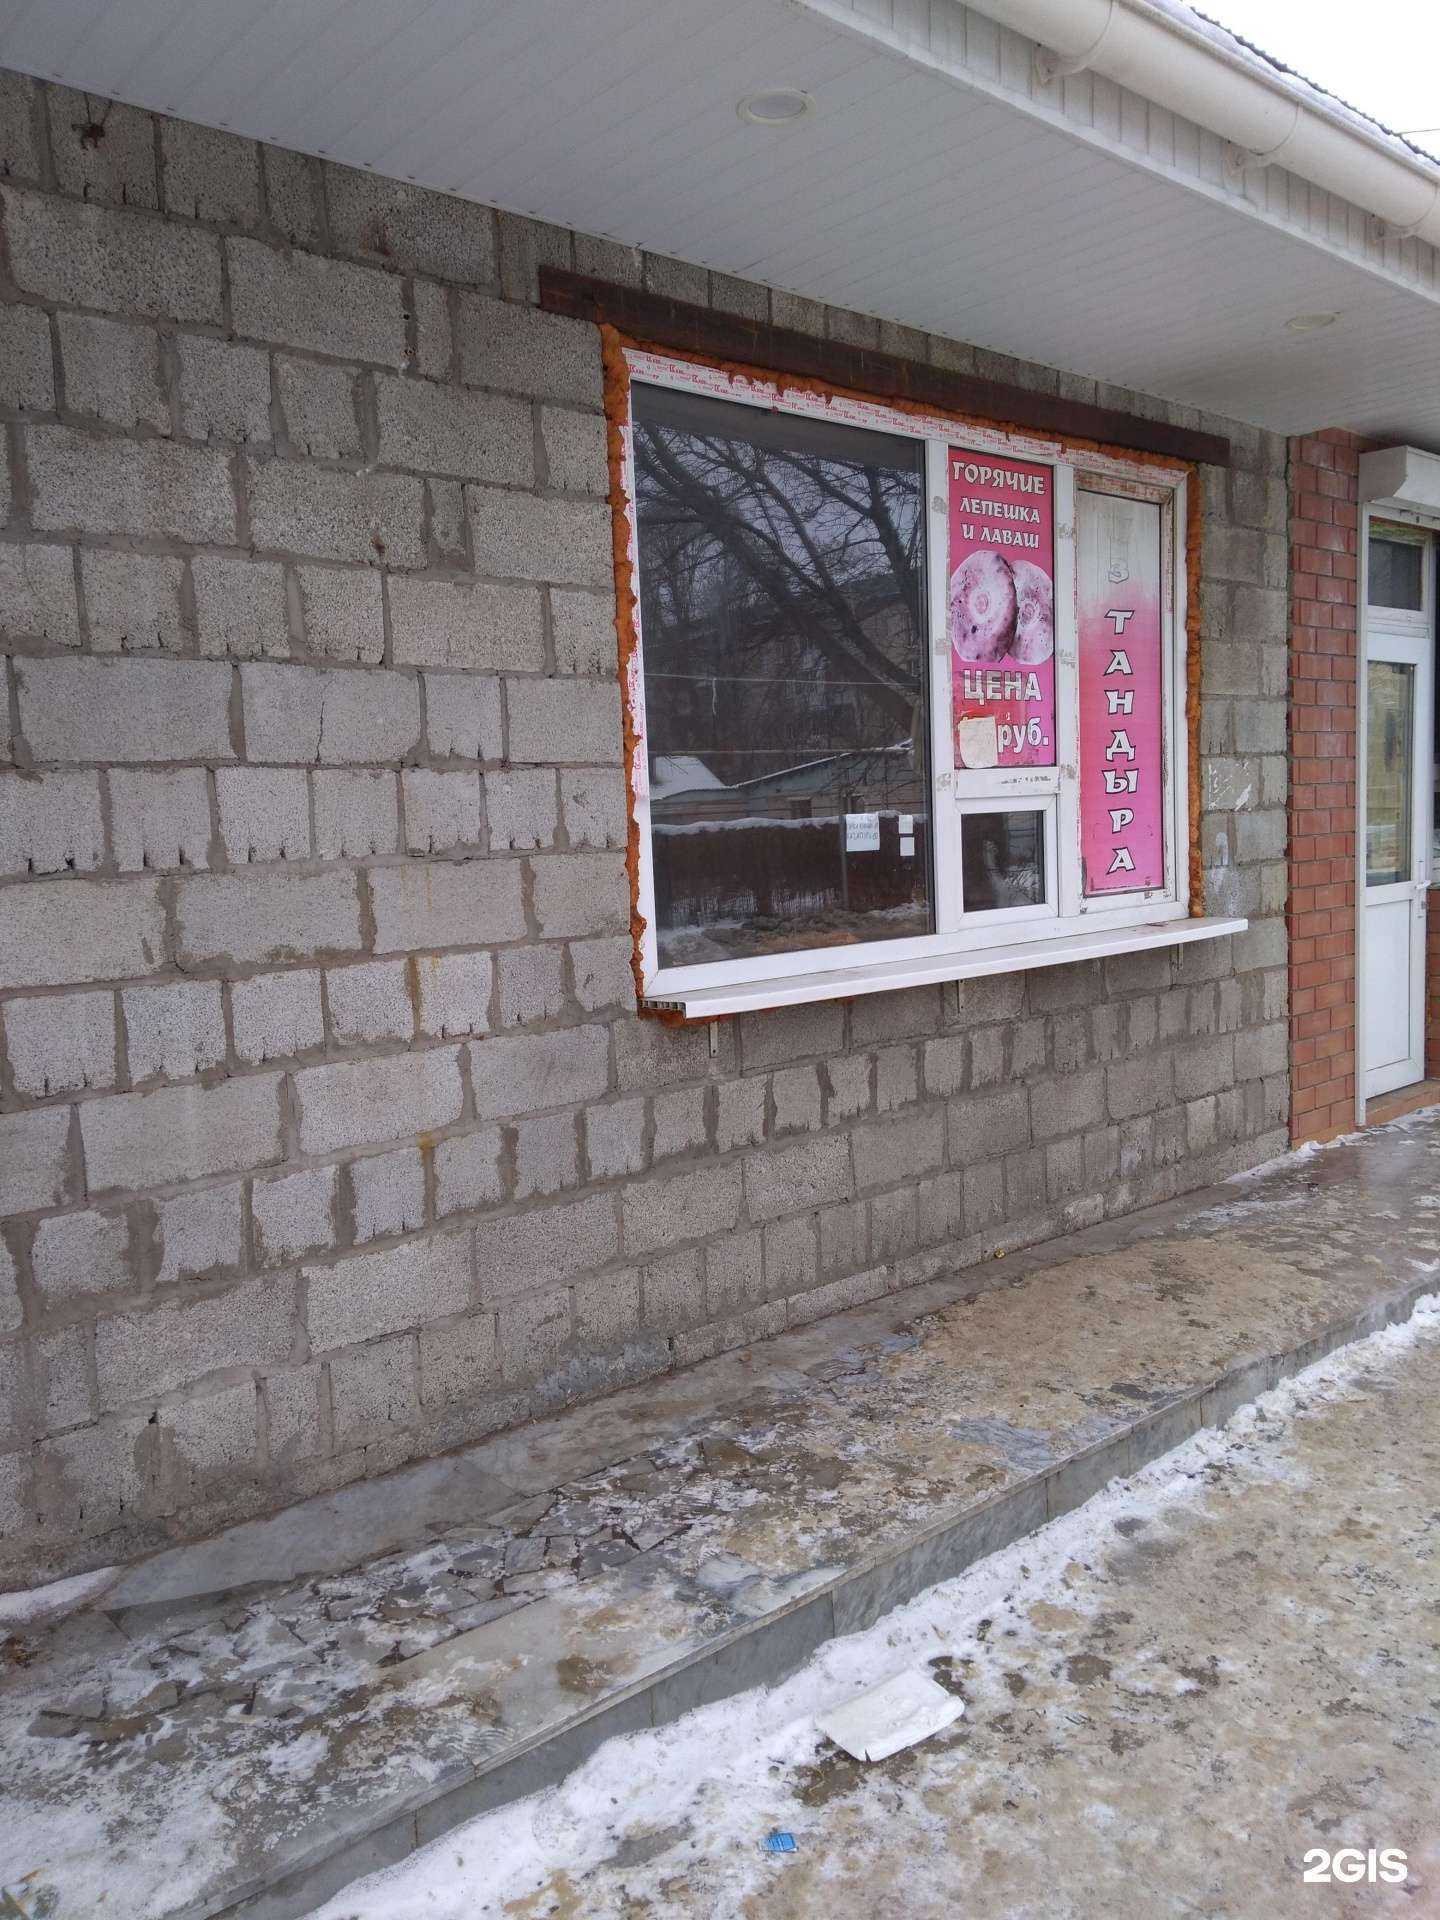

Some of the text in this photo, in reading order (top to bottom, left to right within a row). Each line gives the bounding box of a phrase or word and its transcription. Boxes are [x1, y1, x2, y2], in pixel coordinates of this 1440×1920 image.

[951, 461, 1046, 496] ГОРЯЧИЕ
[959, 496, 1041, 524] ЛЕПЕШКА
[961, 523, 975, 541] И
[980, 526, 1040, 550] ЛАВАШ
[962, 668, 1043, 706] ЦЕНА
[997, 716, 1050, 754] руб.
